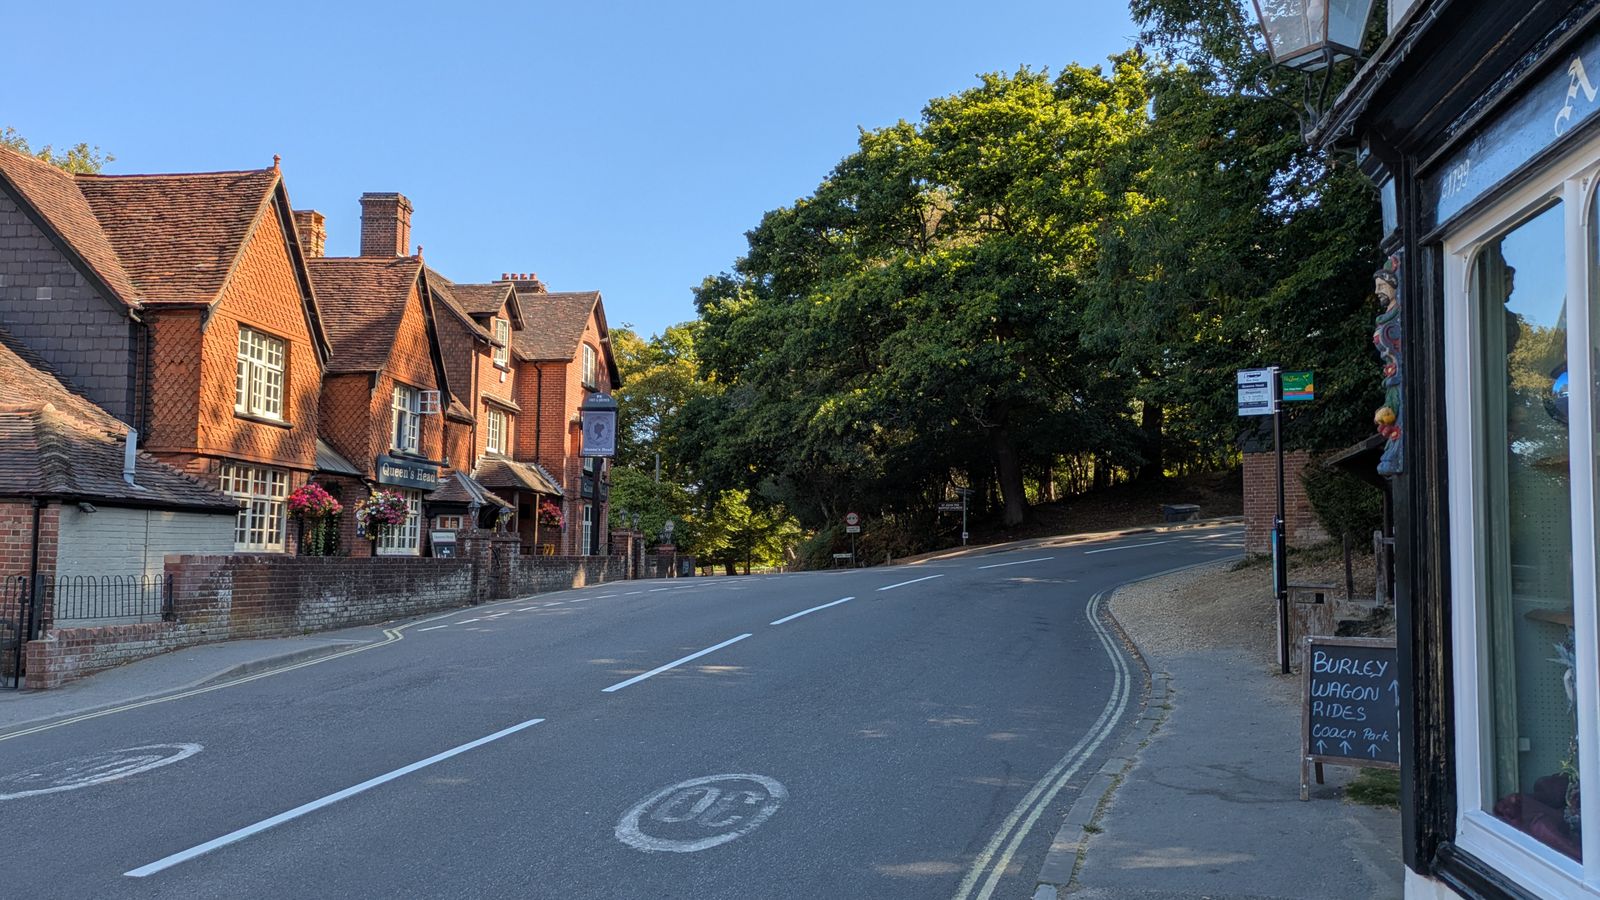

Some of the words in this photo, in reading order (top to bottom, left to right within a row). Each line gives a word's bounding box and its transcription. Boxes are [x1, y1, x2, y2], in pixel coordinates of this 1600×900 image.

[1554, 55, 1599, 137] A
[382, 462, 415, 480] Queen's
[416, 468, 436, 483] Head
[1312, 679, 1379, 701] WAGON
[1312, 701, 1366, 721] RIDES
[1363, 727, 1390, 743] Park
